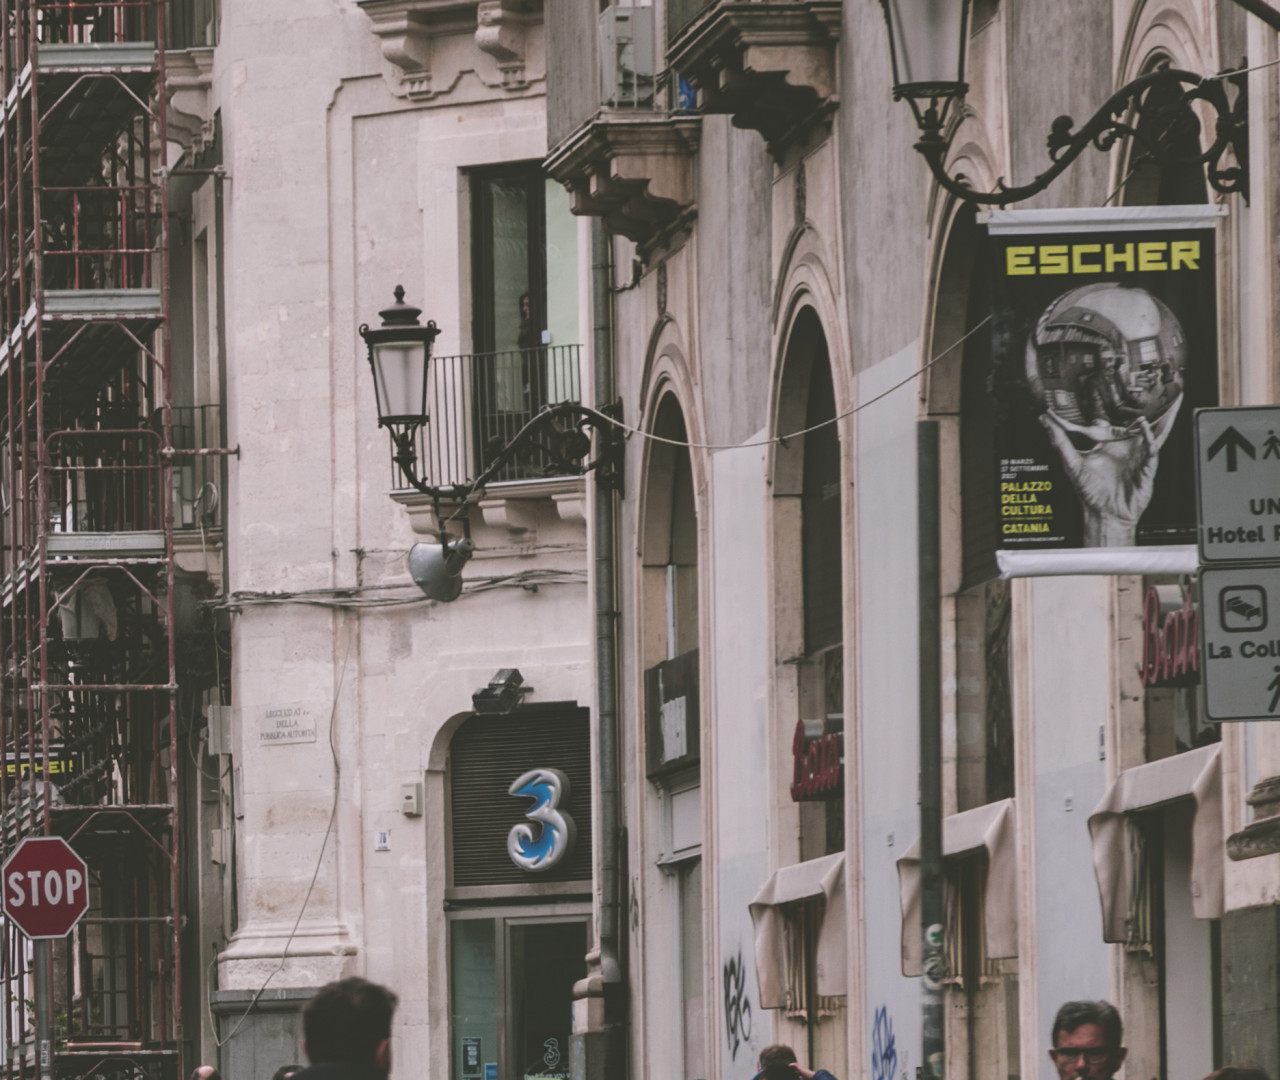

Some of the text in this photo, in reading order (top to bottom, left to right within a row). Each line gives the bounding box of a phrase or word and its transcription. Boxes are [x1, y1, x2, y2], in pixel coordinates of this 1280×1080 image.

[1006, 241, 1200, 275] ESCHER
[1001, 481, 1052, 491] PALAZZO
[1001, 493, 1037, 503] DELLA
[1001, 505, 1053, 515] CULTURA
[1002, 523, 1050, 534] CATANIA
[1208, 525, 1265, 544] Hotel
[1208, 642, 1231, 660] La
[8, 869, 82, 907] STOP
